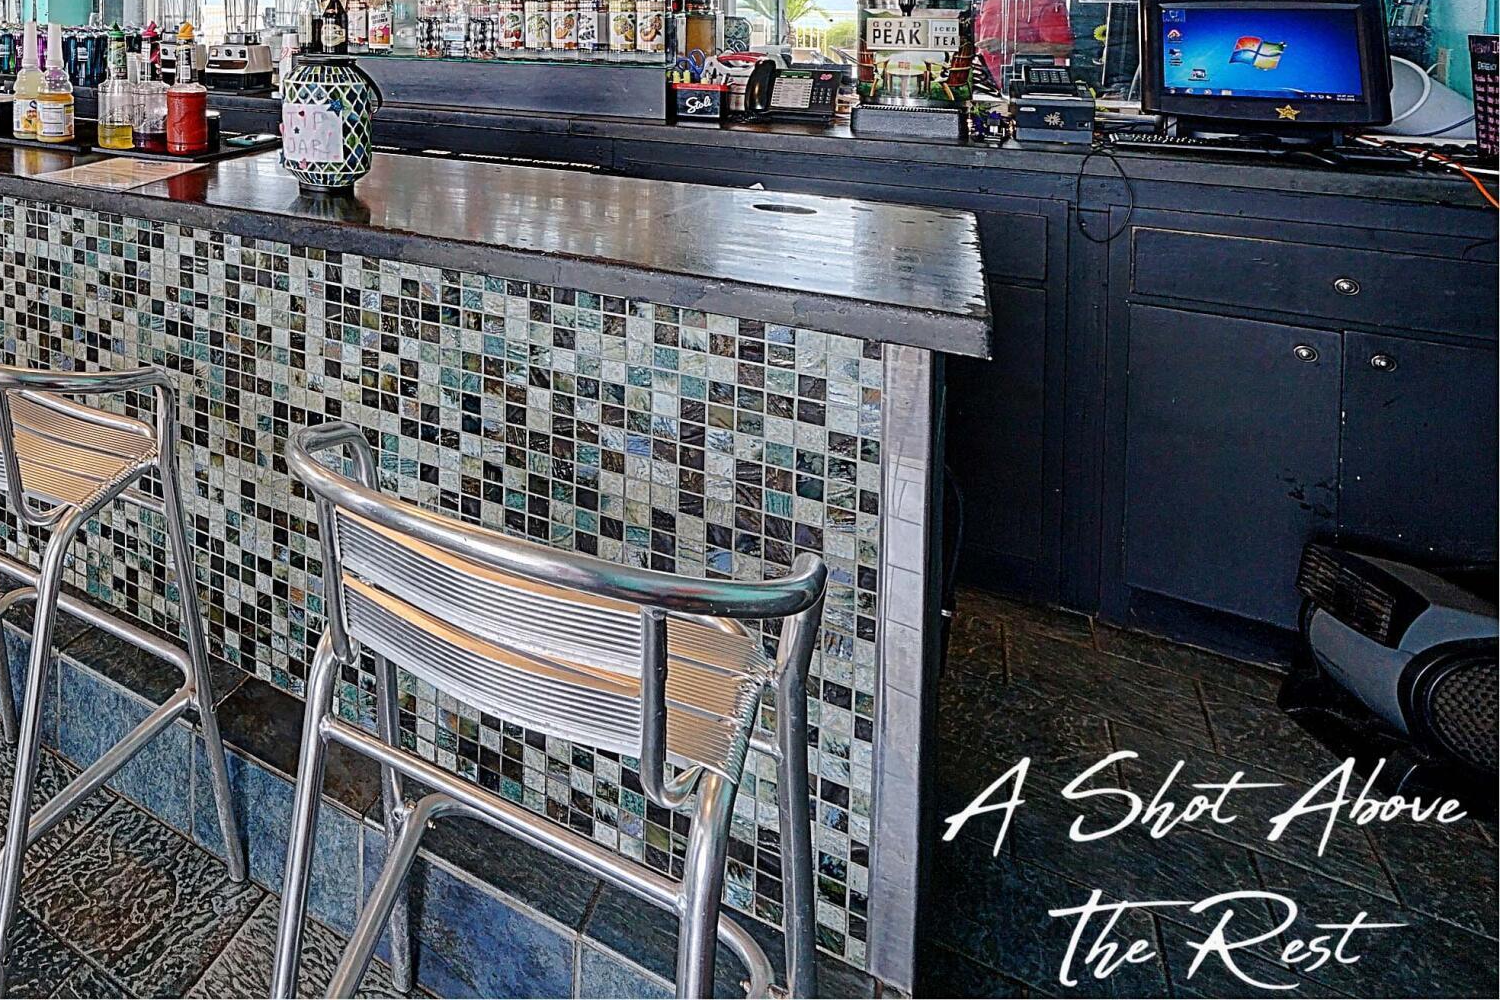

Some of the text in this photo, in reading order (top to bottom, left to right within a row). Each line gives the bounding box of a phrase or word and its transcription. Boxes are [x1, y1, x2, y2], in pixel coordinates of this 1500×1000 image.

[872, 29, 921, 44] PEAK
[934, 37, 956, 46] TEA
[686, 94, 712, 114] Stoli
[287, 110, 328, 130] TIP
